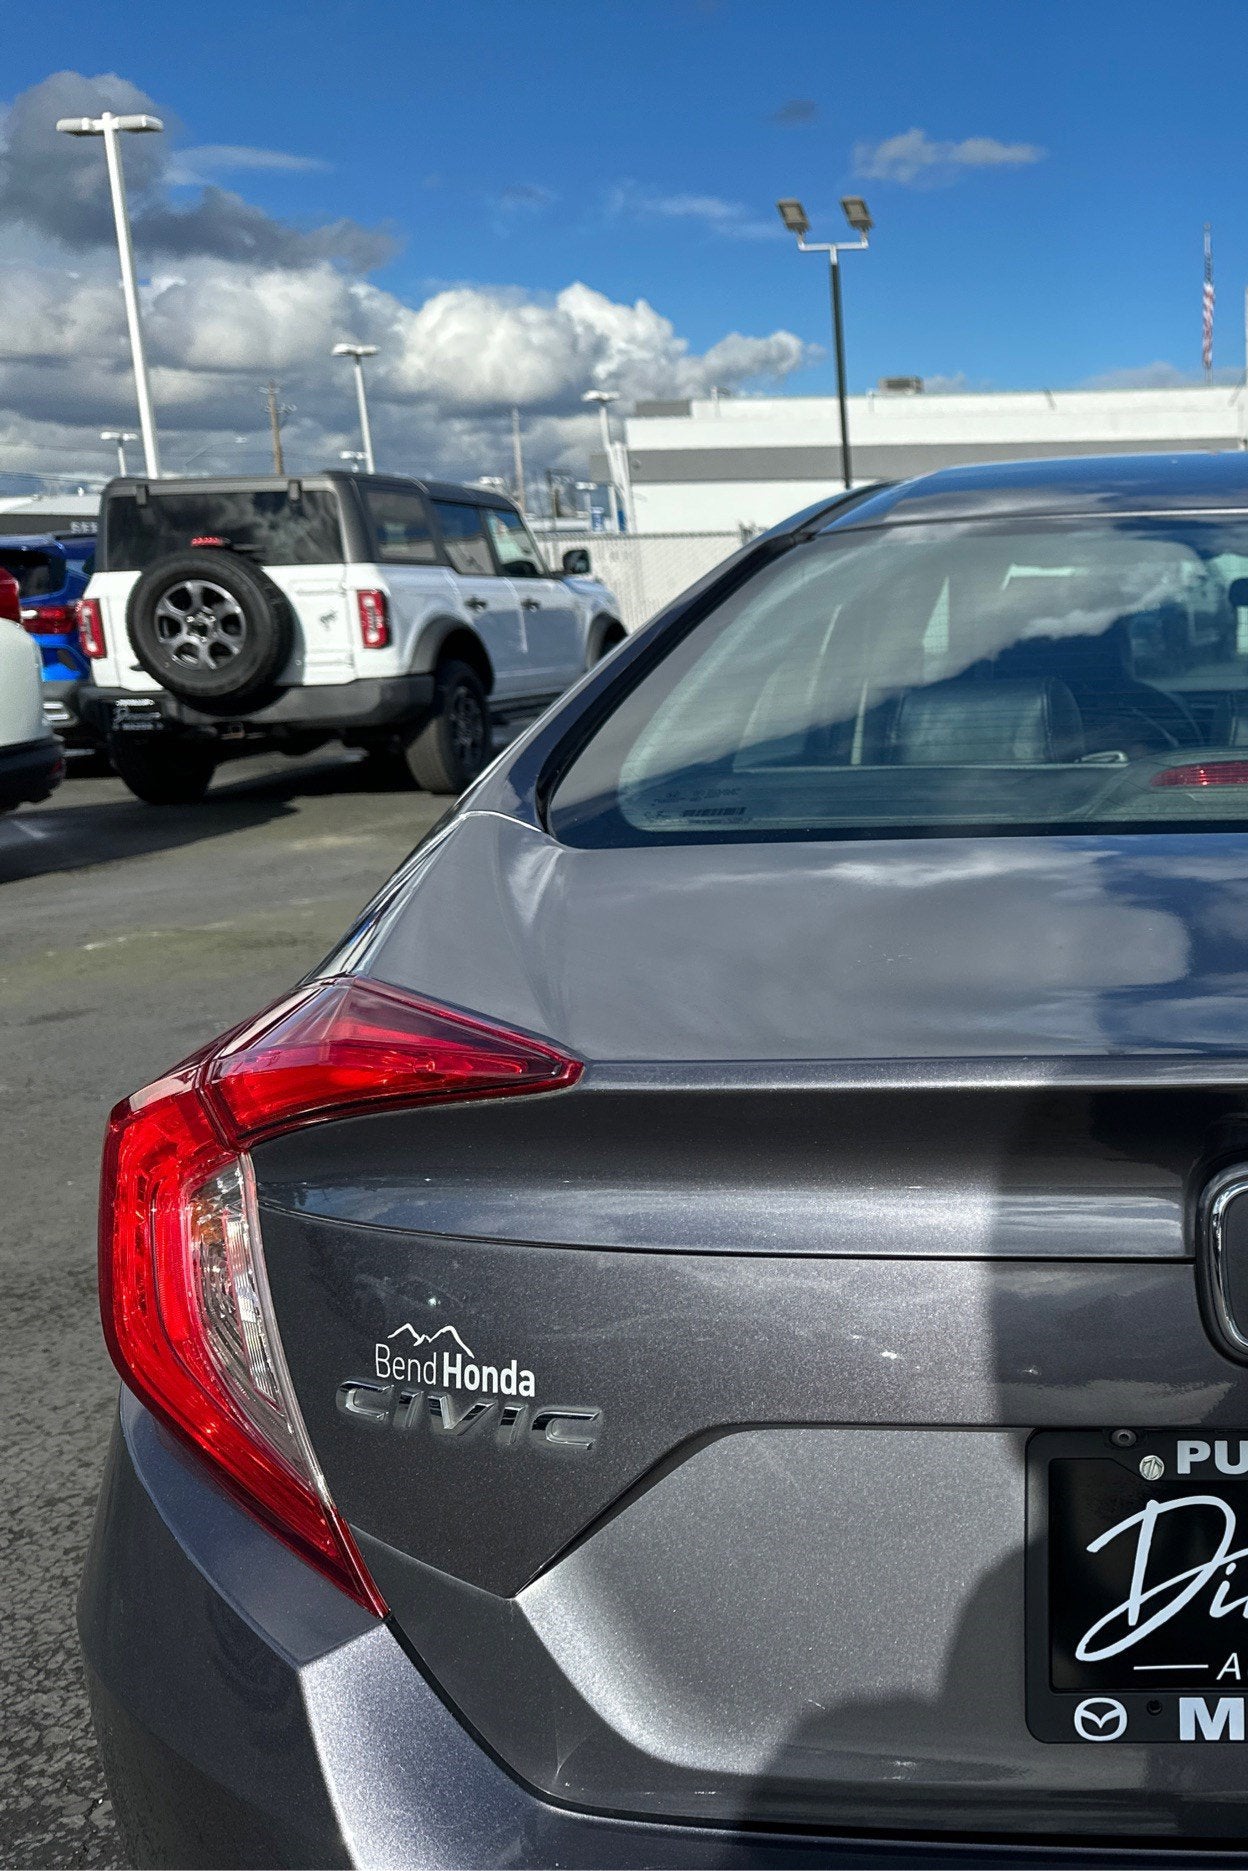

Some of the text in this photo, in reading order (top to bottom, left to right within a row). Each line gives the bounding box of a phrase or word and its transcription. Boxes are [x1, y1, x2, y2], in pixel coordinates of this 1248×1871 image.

[374, 1343, 536, 1398] Bend Honda
[334, 1379, 603, 1450] CIVIC
